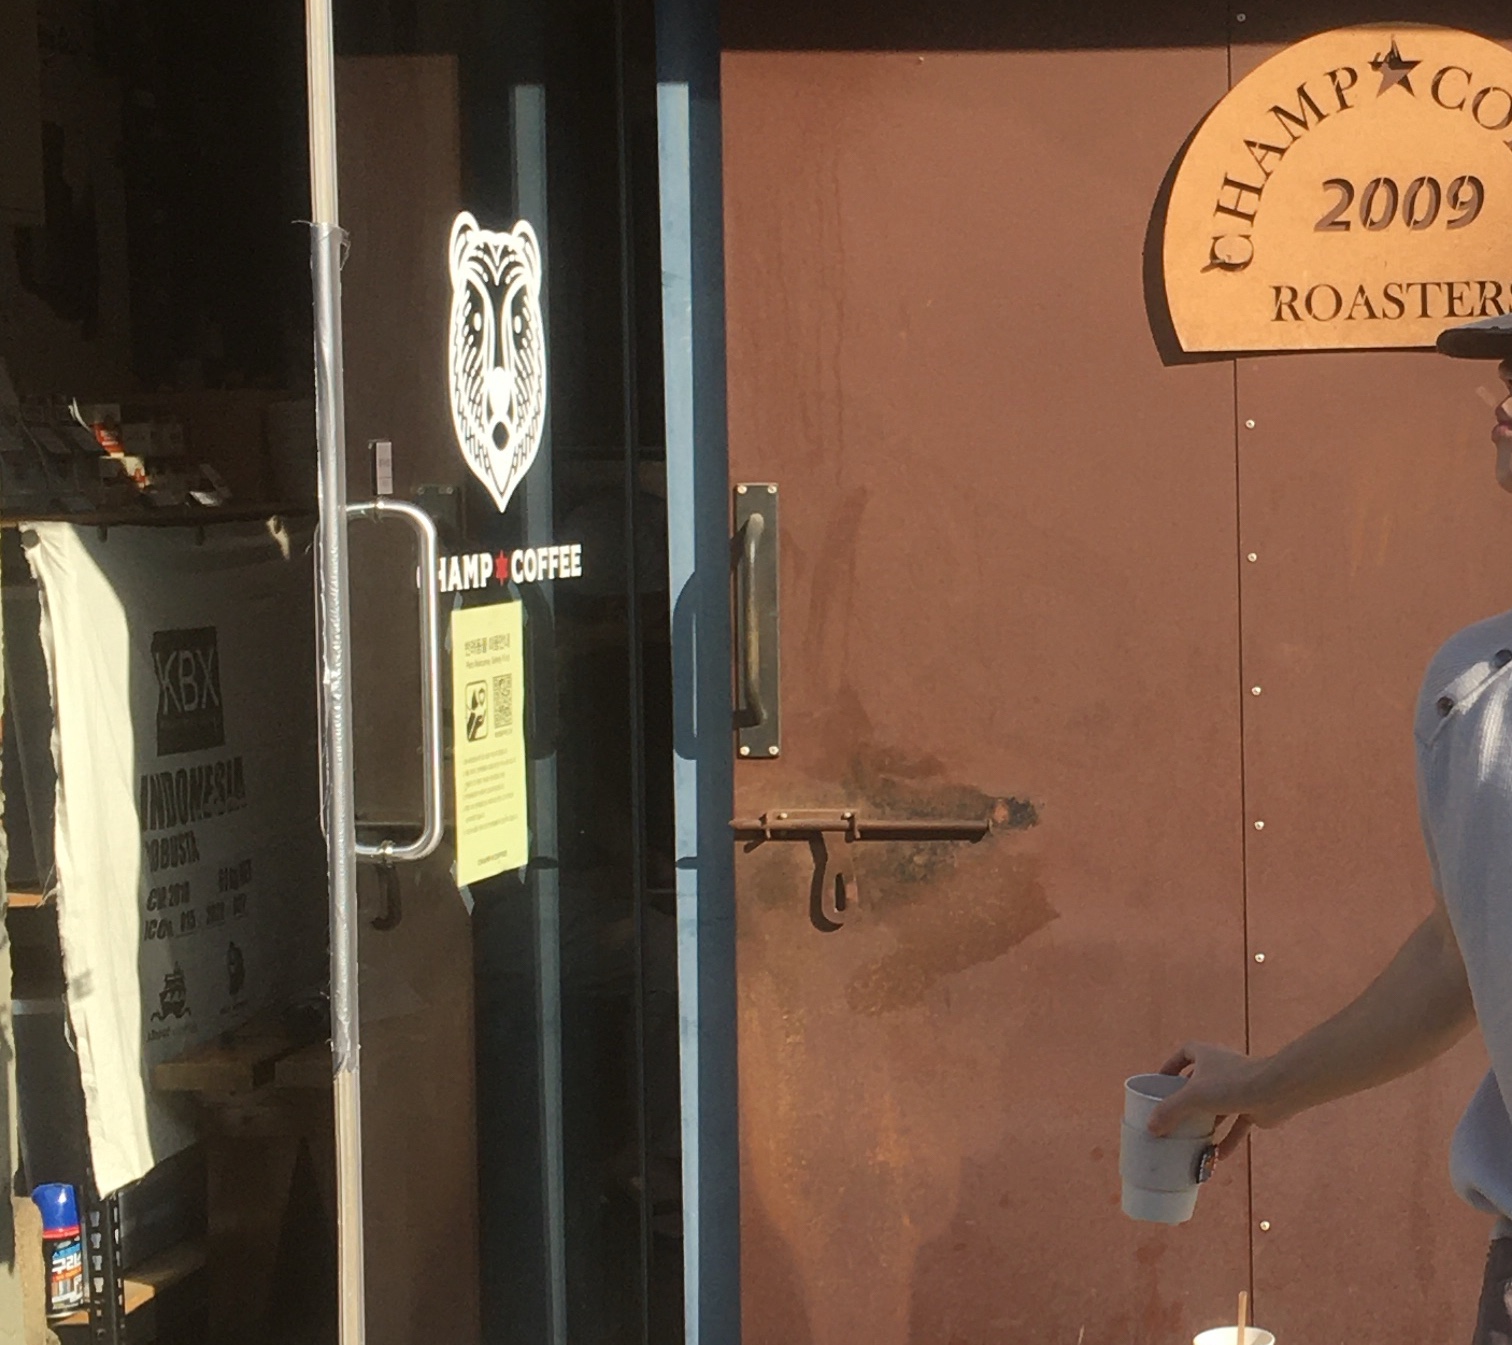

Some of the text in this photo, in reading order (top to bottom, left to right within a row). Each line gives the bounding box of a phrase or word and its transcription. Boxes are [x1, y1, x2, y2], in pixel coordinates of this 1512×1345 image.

[1203, 65, 1359, 273] CHAMP
[1313, 174, 1485, 233] 2009
[416, 544, 583, 593] HAMP COFFEE
[154, 649, 220, 716] KBX
